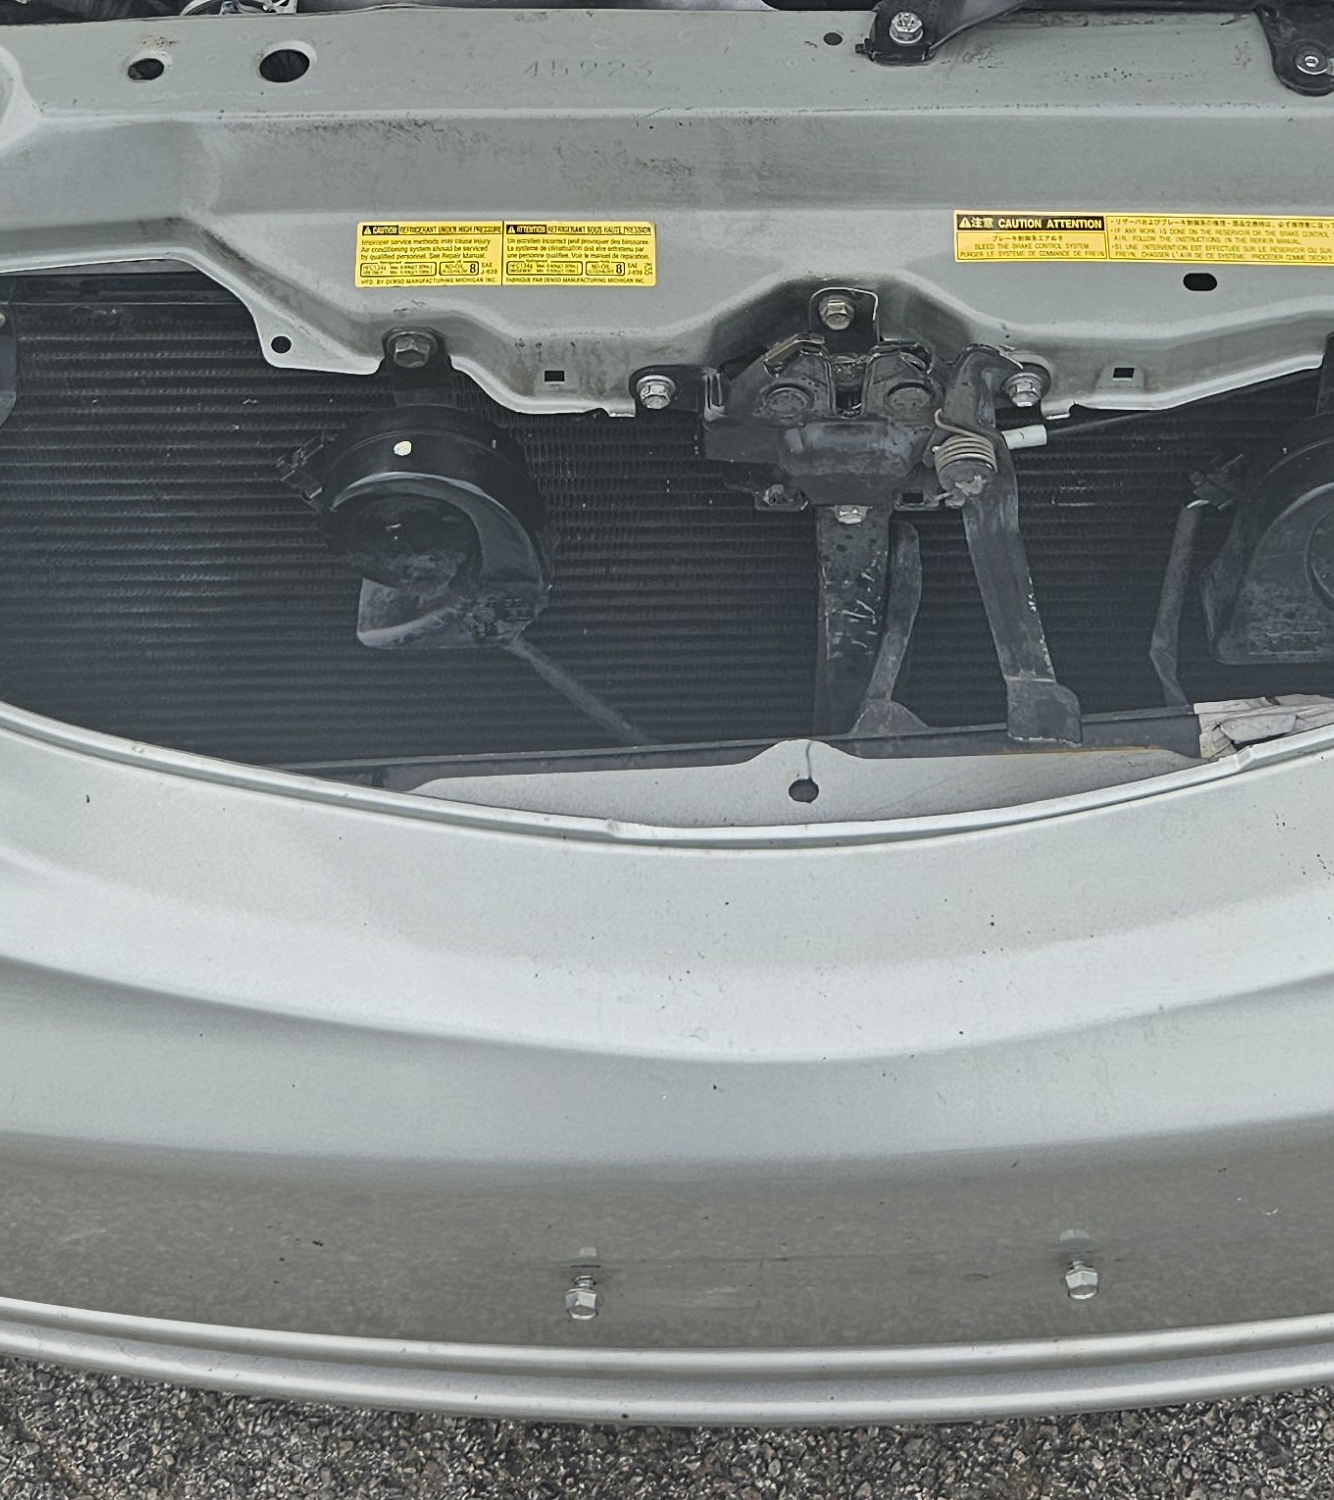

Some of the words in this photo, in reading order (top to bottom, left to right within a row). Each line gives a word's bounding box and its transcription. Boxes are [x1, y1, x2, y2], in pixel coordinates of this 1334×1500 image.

[998, 218, 1042, 229] CAUTION
[1047, 219, 1102, 229] ATTENTION
[469, 264, 476, 273] 8
[616, 264, 623, 274] 8
